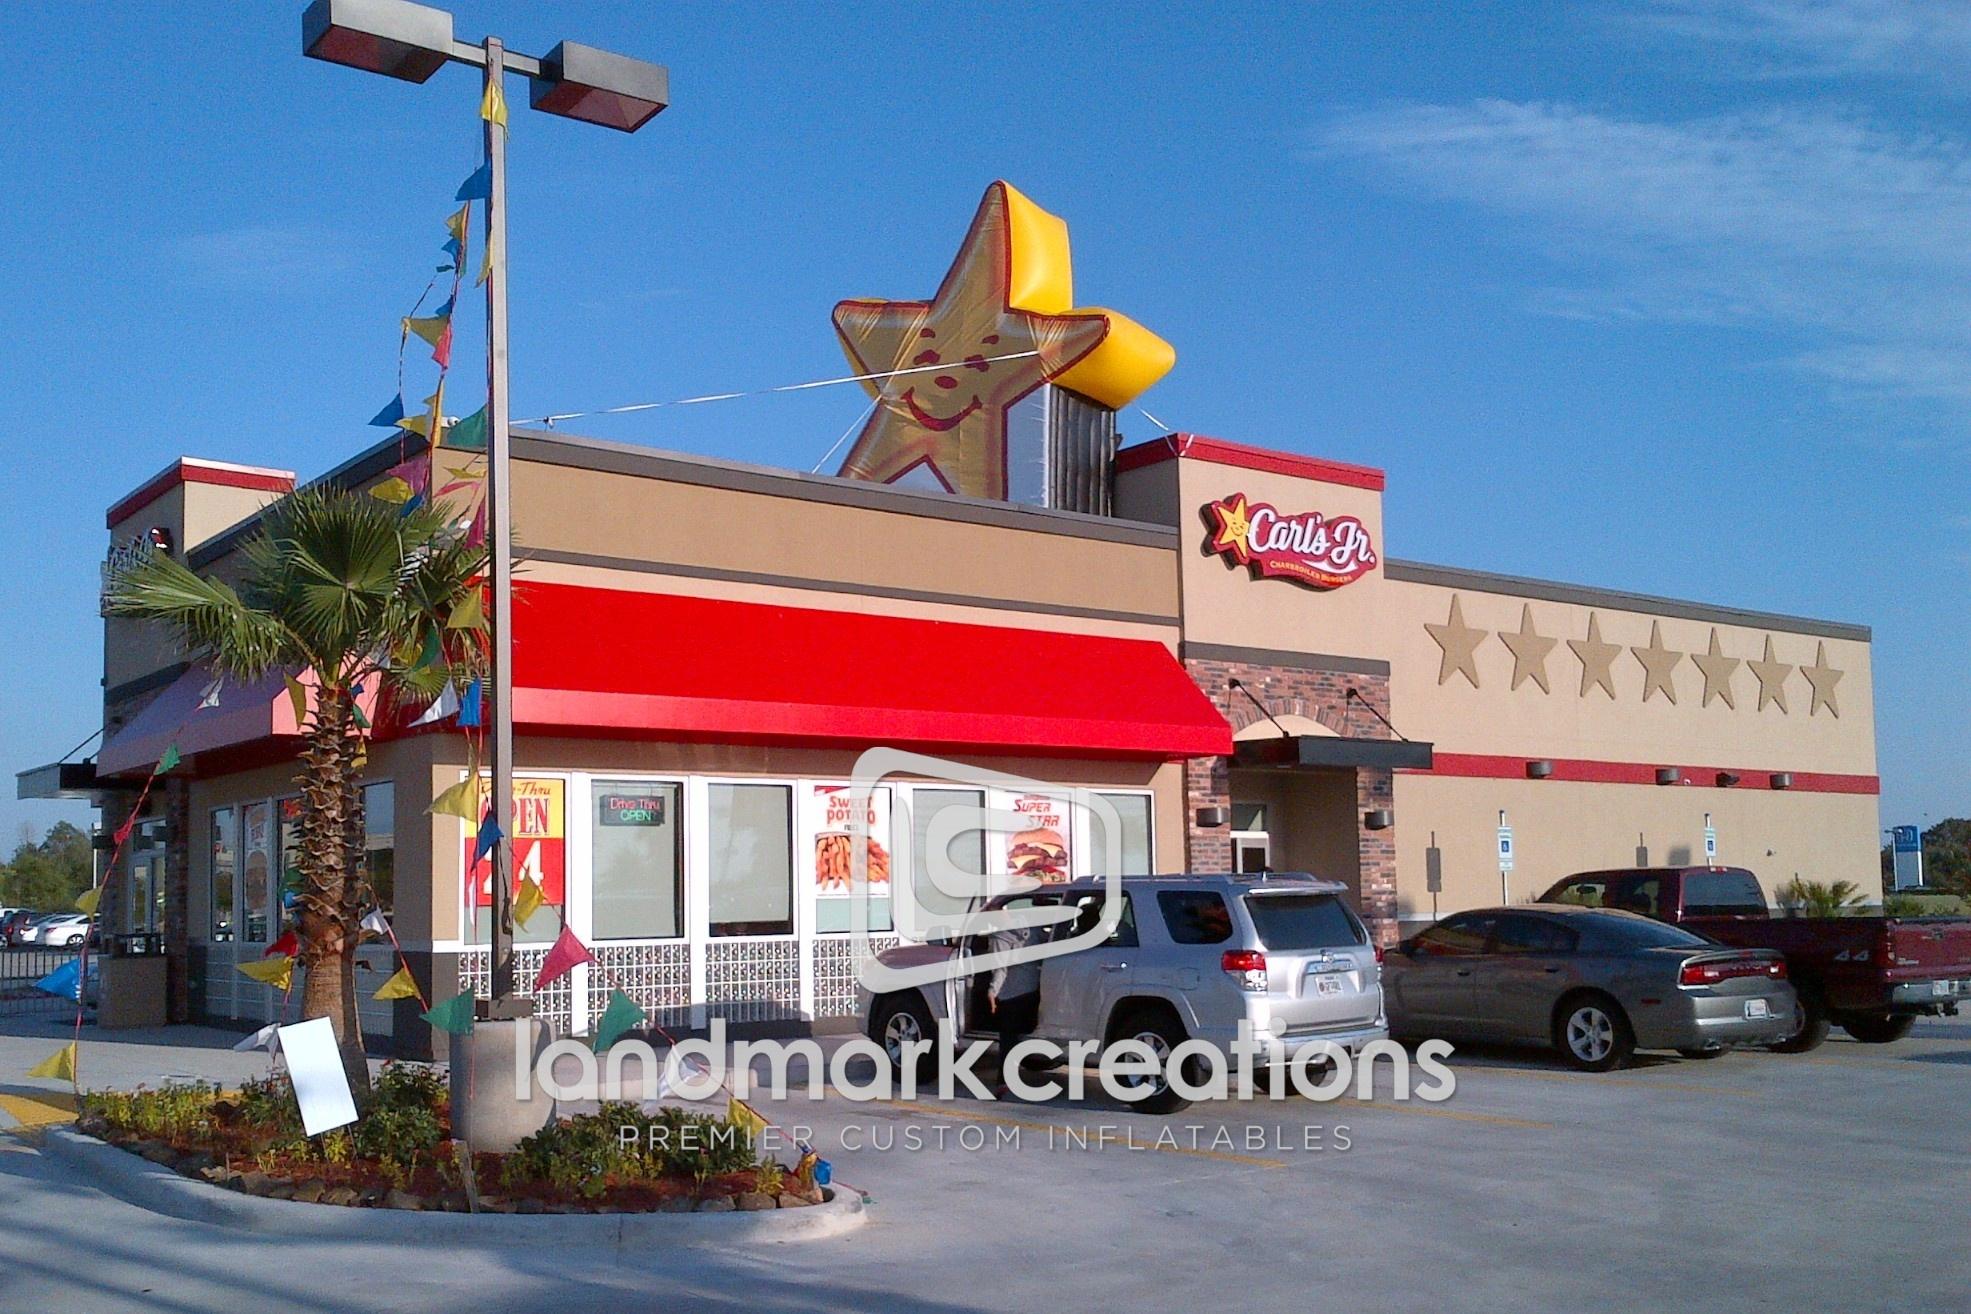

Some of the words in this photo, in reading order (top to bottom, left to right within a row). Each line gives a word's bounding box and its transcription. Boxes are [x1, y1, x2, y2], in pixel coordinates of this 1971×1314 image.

[1249, 508, 1331, 556] Carl's
[1329, 521, 1376, 565] Jr.
[610, 797, 637, 809] Drive
[1012, 799, 1052, 813] SUPER
[620, 809, 652, 821] OPEN
